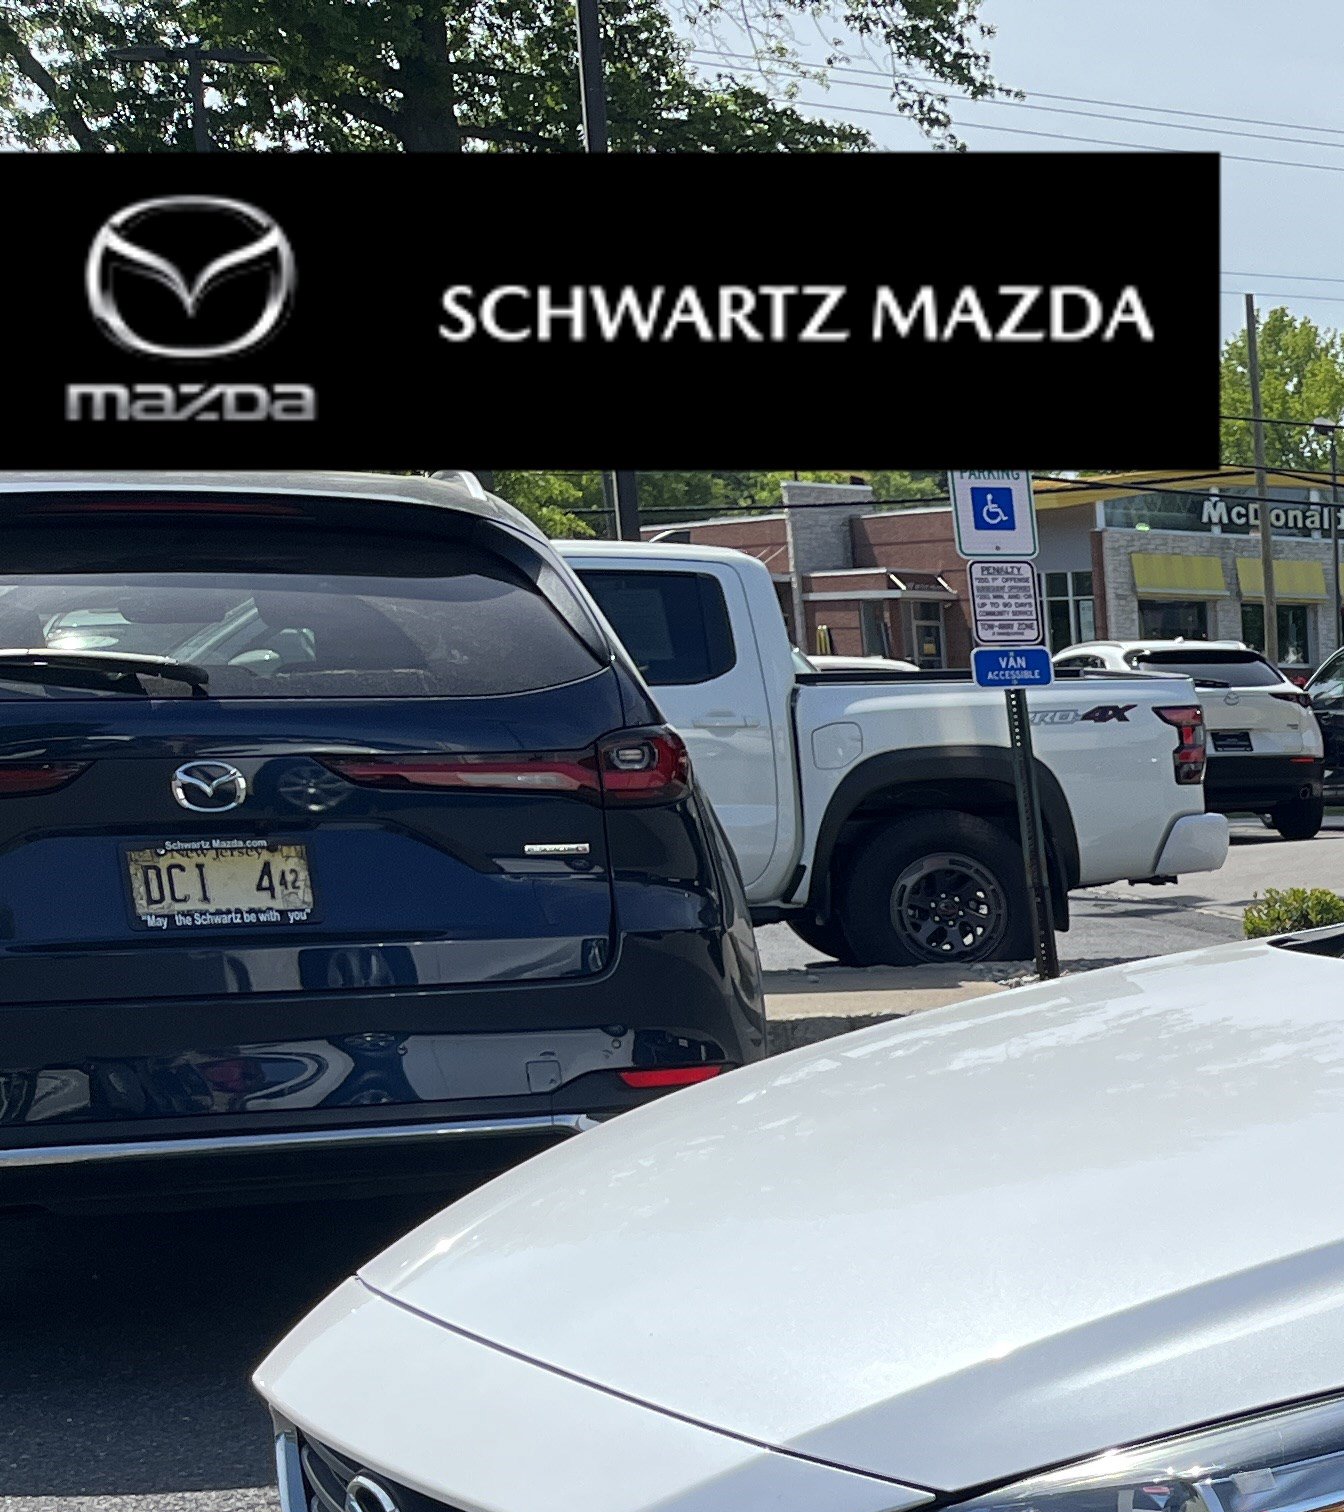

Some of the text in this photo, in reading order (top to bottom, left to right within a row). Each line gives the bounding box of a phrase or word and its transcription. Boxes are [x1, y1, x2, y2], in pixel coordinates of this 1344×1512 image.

[981, 565, 1022, 574] PENALTY
[1017, 622, 1035, 631] ZONE
[999, 656, 1026, 669] VAN
[987, 669, 1040, 680] ACCESSIBLE
[165, 839, 267, 850] Schwartz Mazda.com
[141, 863, 211, 905] DCI
[175, 913, 192, 926] the
[194, 912, 242, 926] Schwartz
[244, 911, 256, 923] be
[258, 910, 281, 922] with
